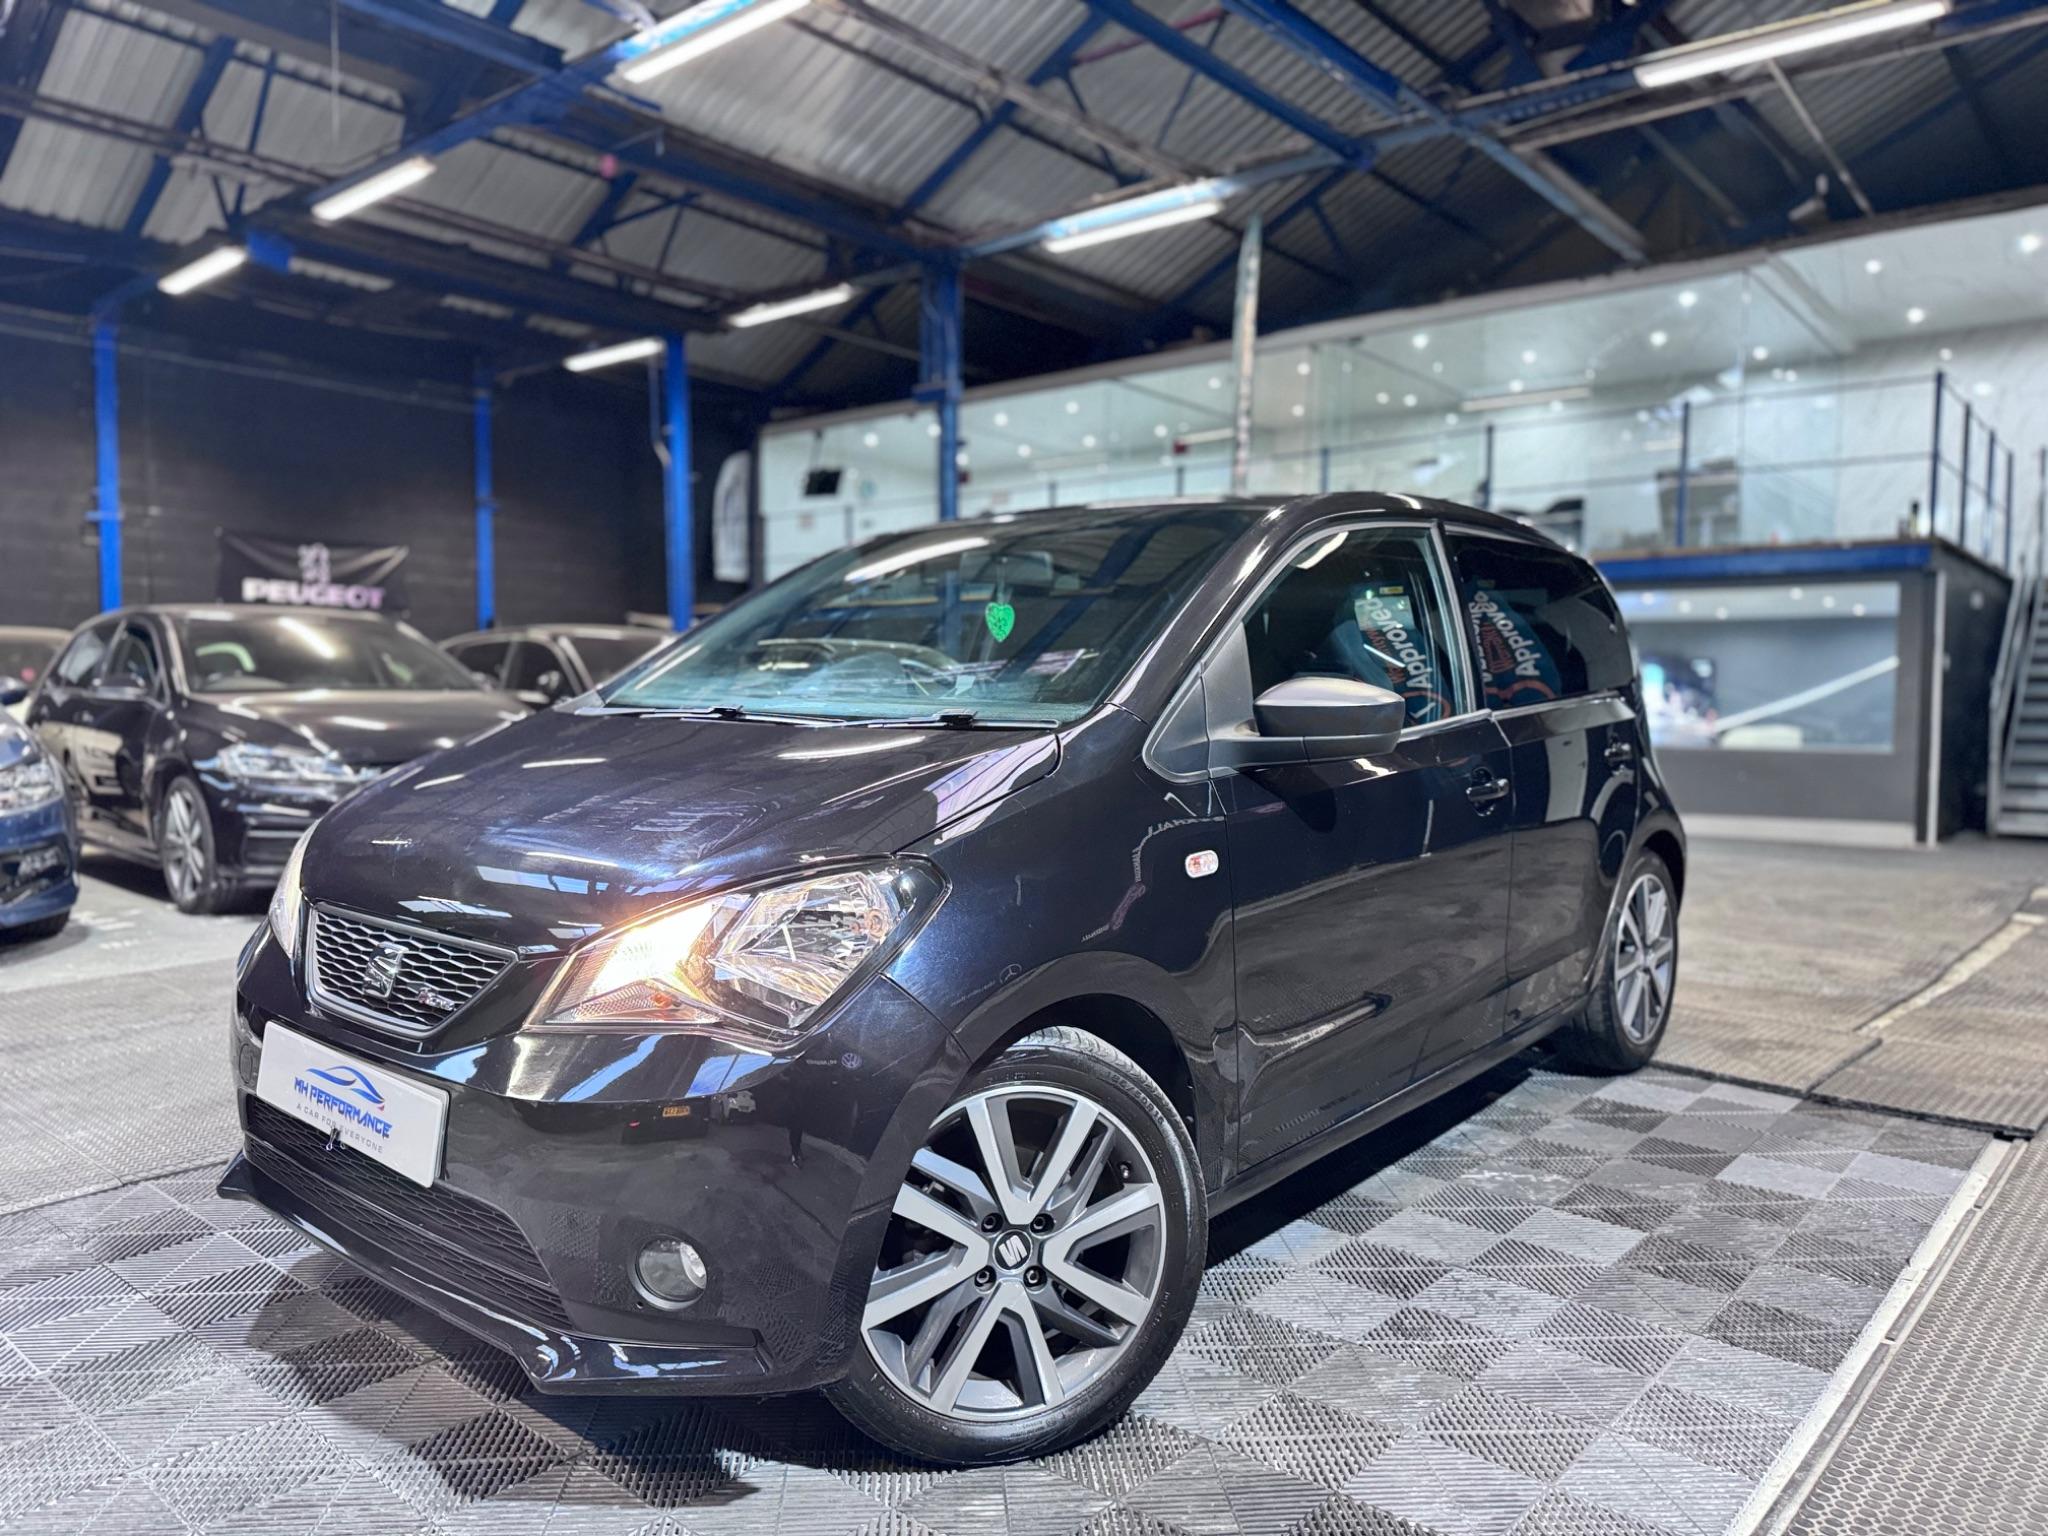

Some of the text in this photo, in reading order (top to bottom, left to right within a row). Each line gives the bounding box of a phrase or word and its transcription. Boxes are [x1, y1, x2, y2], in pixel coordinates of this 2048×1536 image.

[242, 576, 385, 609] PEUGEOT
[1363, 596, 1433, 689] Approved
[294, 1076, 393, 1139] MH PERFORMANCE
[296, 1103, 383, 1153] A CAR FOR EVERYONE
